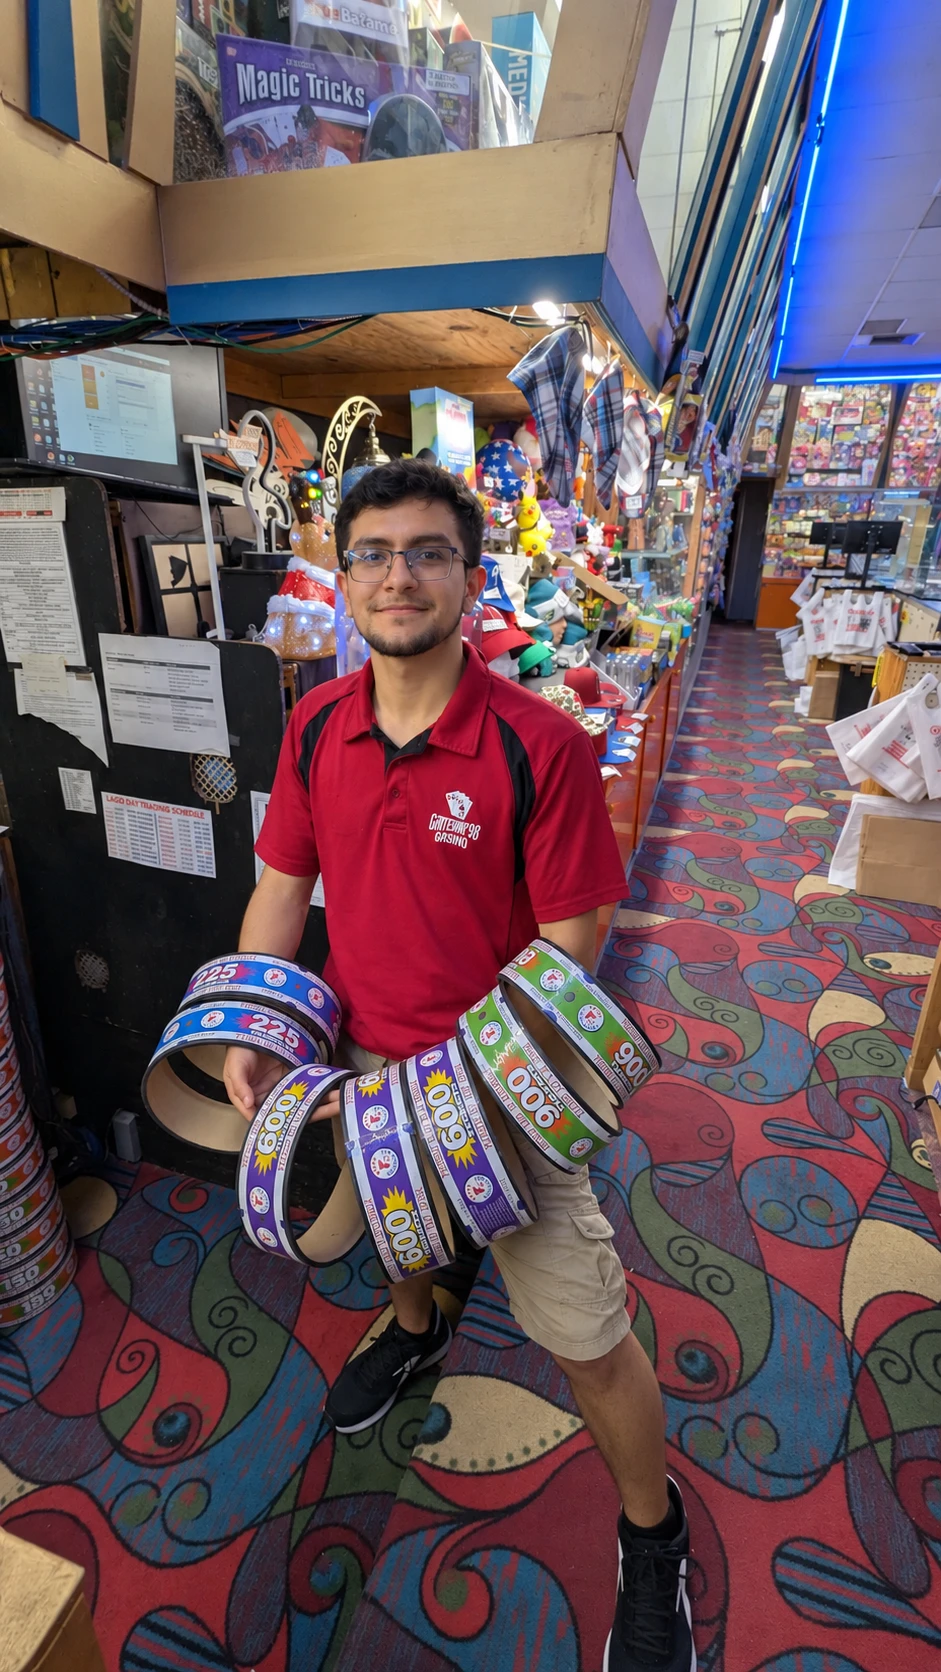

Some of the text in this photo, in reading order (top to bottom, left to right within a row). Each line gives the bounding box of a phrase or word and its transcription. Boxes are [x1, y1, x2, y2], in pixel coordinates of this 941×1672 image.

[236, 62, 365, 108] Magic Tricks
[193, 963, 239, 989] 225
[248, 1013, 300, 1049] 225
[257, 1094, 298, 1155] 600
